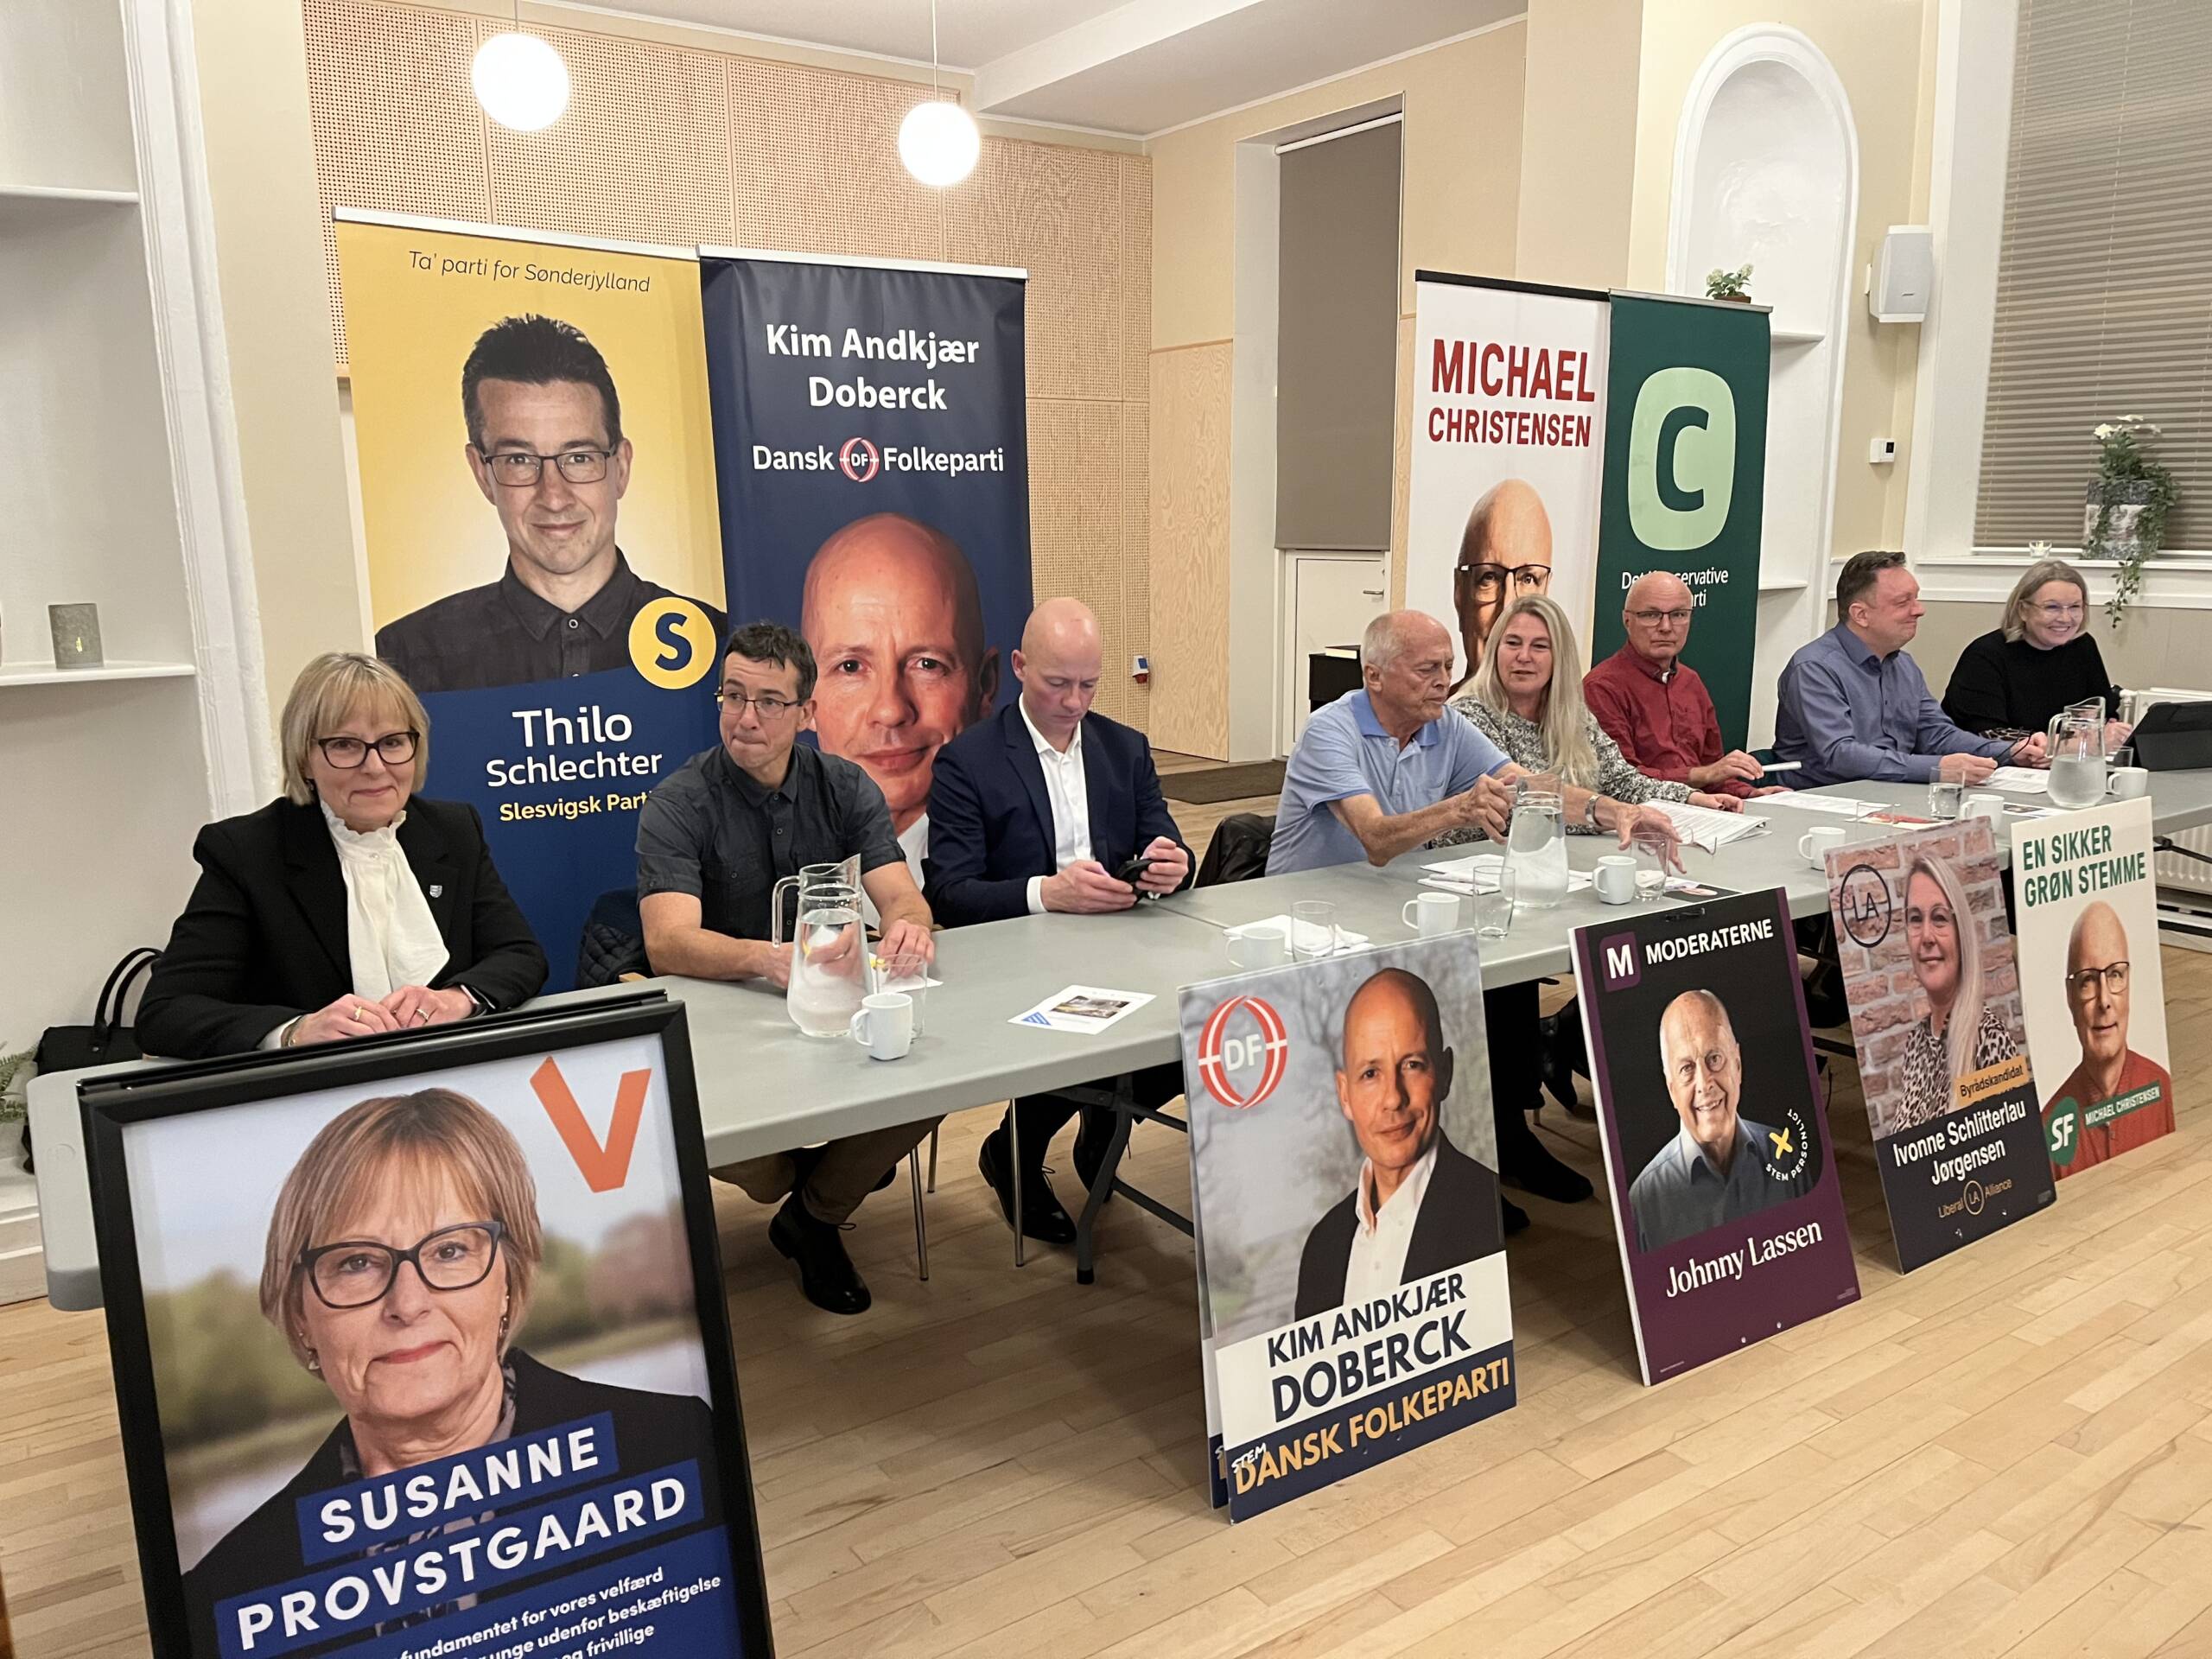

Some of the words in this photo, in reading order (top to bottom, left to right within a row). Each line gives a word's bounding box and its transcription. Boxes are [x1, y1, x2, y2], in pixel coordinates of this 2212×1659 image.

[409, 251, 437, 270] Ta'
[441, 253, 489, 280] parti
[492, 261, 520, 281] for
[524, 264, 651, 292] Sønderjylland
[766, 323, 832, 359] Kim
[840, 328, 980, 366] Andkjær
[1432, 339, 1596, 403] MICHAEL
[808, 377, 948, 411] Doberck
[1428, 407, 1592, 448] CHRISTENSEN
[752, 445, 835, 473] Dansk
[850, 451, 869, 470] DF
[883, 446, 1005, 476] Folkeparti
[1655, 405, 1710, 512] C
[655, 612, 693, 671] S
[512, 705, 632, 747] Thilo
[486, 752, 663, 787] Schlechter
[499, 797, 602, 822] Slesvigsk
[2022, 841, 2046, 871] EN
[2050, 824, 2112, 863] SIKKER
[2024, 873, 2073, 907] GRØN
[2078, 851, 2146, 894] STEMME
[1852, 891, 1880, 922] LA
[1605, 944, 1634, 979] M
[1645, 918, 1774, 964] MODERATERNE
[1223, 1033, 1262, 1071] DF
[1960, 1064, 2024, 1098] Byrådskandidat
[530, 1056, 652, 1193] V
[2085, 1103, 2115, 1125] MICHAEL
[2117, 1086, 2161, 1113] CHRISTENSEN
[1893, 1132, 1946, 1167] Ivonne
[1947, 1100, 2026, 1146] Schlitterlau
[2051, 1113, 2075, 1152] SF
[1765, 1163, 1789, 1181] STEM
[1931, 1140, 2006, 1185] Jørgensen
[1938, 1198, 1964, 1218] Liberal
[1969, 1191, 1980, 1205] LA
[1666, 1246, 1745, 1298] Johnny
[1750, 1220, 1822, 1265] Lassen
[1268, 1320, 1324, 1368] KIM
[1331, 1272, 1466, 1344] ANDKJÆR
[1272, 1309, 1471, 1423] DOBERCK
[1235, 1423, 1344, 1495] DANSK
[1349, 1357, 1510, 1448] FOLKEPARTI
[1231, 1442, 1267, 1473] STEM
[320, 1427, 599, 1544] SUSANNE
[236, 1477, 688, 1650] PROVSTGAARD
[522, 1606, 548, 1628] for
[550, 1594, 596, 1619] vores
[600, 1566, 664, 1601] velfærd
[537, 1615, 606, 1649] udenfor
[607, 1576, 721, 1624] beskæftigelse
[586, 1625, 655, 1658] frivillige
